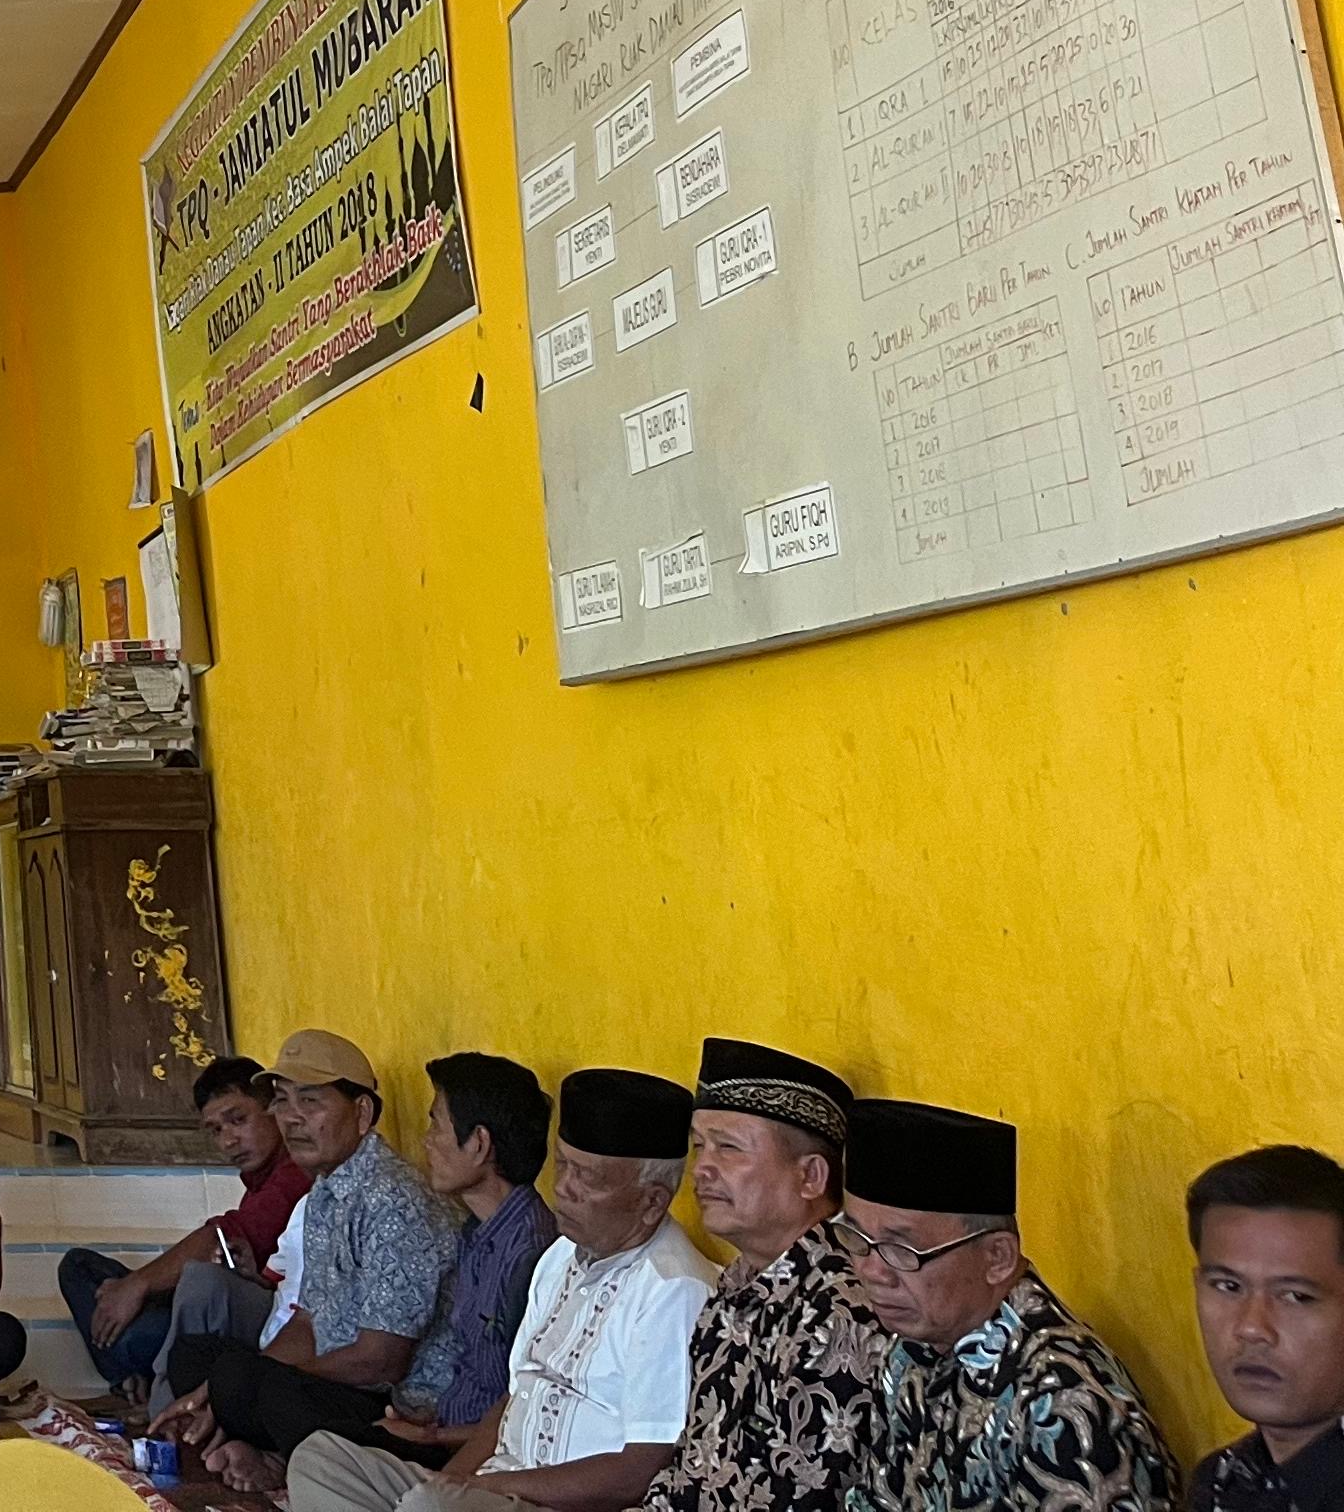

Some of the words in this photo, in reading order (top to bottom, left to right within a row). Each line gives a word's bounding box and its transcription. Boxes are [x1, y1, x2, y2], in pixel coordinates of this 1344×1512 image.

[1119, 15, 1137, 41] 30
[573, 61, 613, 114] NAGARI
[619, 32, 647, 79] RIAK
[176, 178, 210, 247] TPQ
[218, 68, 311, 205] JAMIATUL
[206, 245, 235, 289] Danau
[233, 215, 263, 265] Tapan
[286, 162, 312, 210] Basa
[313, 114, 360, 193] Ampek
[358, 79, 393, 150] Balai
[393, 47, 443, 115] Tapan
[679, 145, 721, 189] BENDAHARA
[1086, 226, 1128, 259] JUMLAH
[1129, 204, 1169, 238] SANTRI
[1175, 182, 1225, 217] KHATAM
[1225, 161, 1248, 194] PER
[1250, 151, 1293, 179] TAHUN
[206, 268, 266, 354] ANGKATAN
[285, 205, 336, 282] TAHUN
[338, 171, 379, 240] 2018
[301, 292, 333, 333] Yang
[334, 233, 404, 312] Berakhlak
[405, 201, 444, 261] Baik
[719, 236, 740, 264] GURU
[744, 250, 772, 273] NOVITA
[1120, 278, 1165, 312] TAHUN
[1170, 232, 1223, 273] JUMLAH
[1225, 212, 1265, 243] SANTRI
[622, 295, 649, 334] MAJELIS
[649, 287, 667, 321] GURU
[847, 341, 858, 372] B
[870, 326, 913, 362] JUMLAH
[919, 302, 960, 340] SANTRI
[967, 281, 998, 317] BARU
[999, 266, 1018, 302] PER
[1019, 260, 1051, 290] TAHUN
[286, 308, 377, 391] Bermasyarakat
[899, 366, 943, 399] TAHUN
[944, 337, 983, 366] JUMLAH
[1042, 320, 1062, 340] KET
[1131, 358, 1163, 382] 2017
[913, 406, 937, 430] 2016
[1137, 387, 1173, 415] 2018
[646, 414, 663, 440] GURU
[1144, 419, 1179, 445] 2019
[917, 437, 941, 458] 2017
[919, 464, 947, 485] 2018
[1140, 459, 1196, 494] JUMLAH
[770, 506, 799, 538] GURU
[801, 500, 828, 530] FIQH
[663, 551, 682, 578] GURU
[775, 537, 808, 559] ARIPIN,
